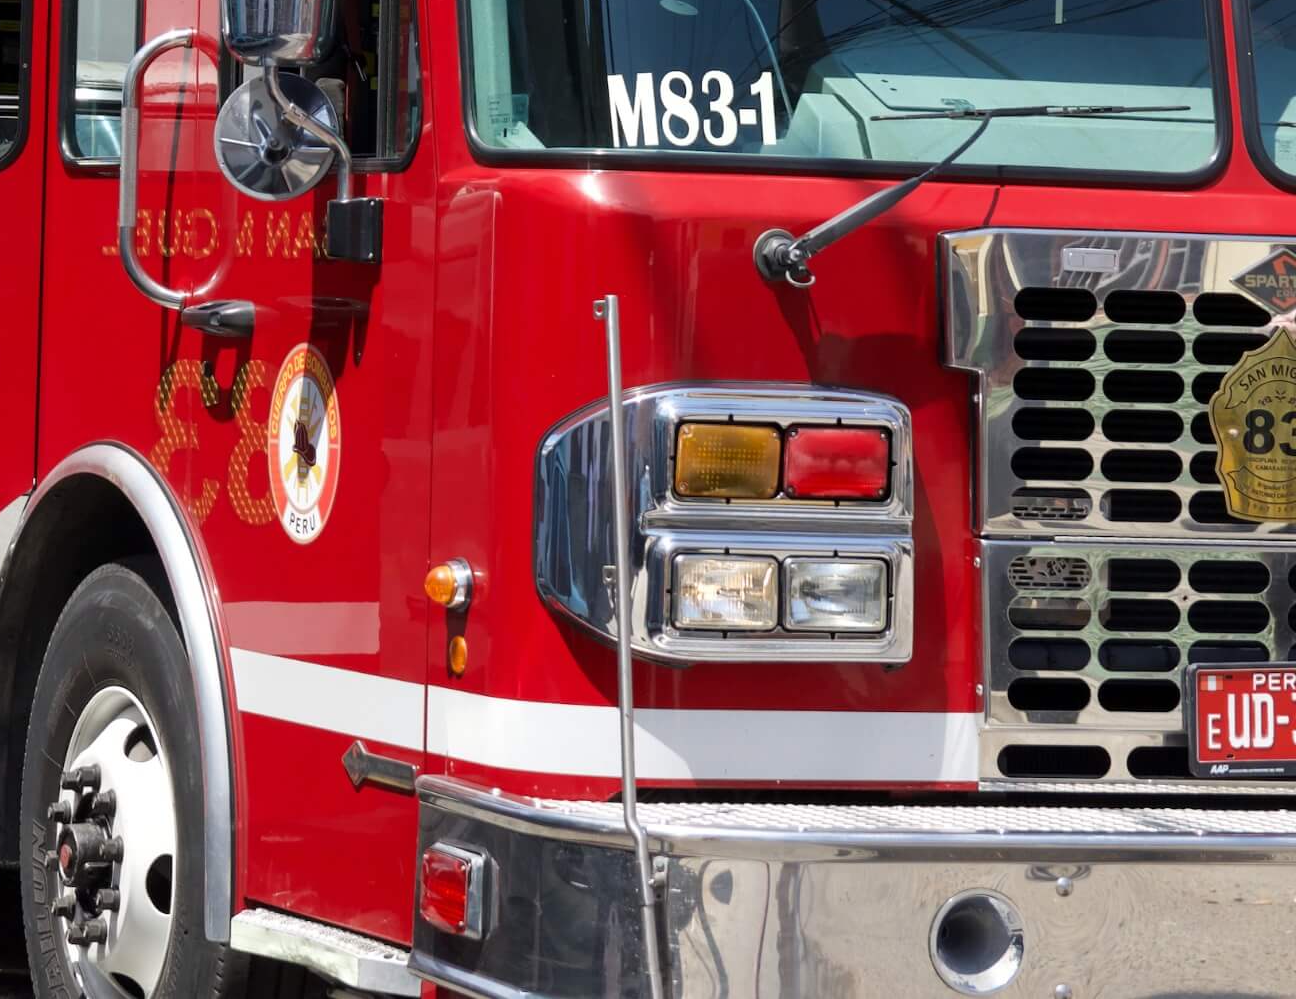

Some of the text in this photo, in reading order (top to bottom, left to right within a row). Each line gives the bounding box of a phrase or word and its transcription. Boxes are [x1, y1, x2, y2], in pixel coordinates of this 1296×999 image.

[607, 70, 777, 148] M83-1
[271, 365, 295, 435] CUERPO
[1239, 367, 1267, 392] SAN
[289, 512, 316, 534] PERU
